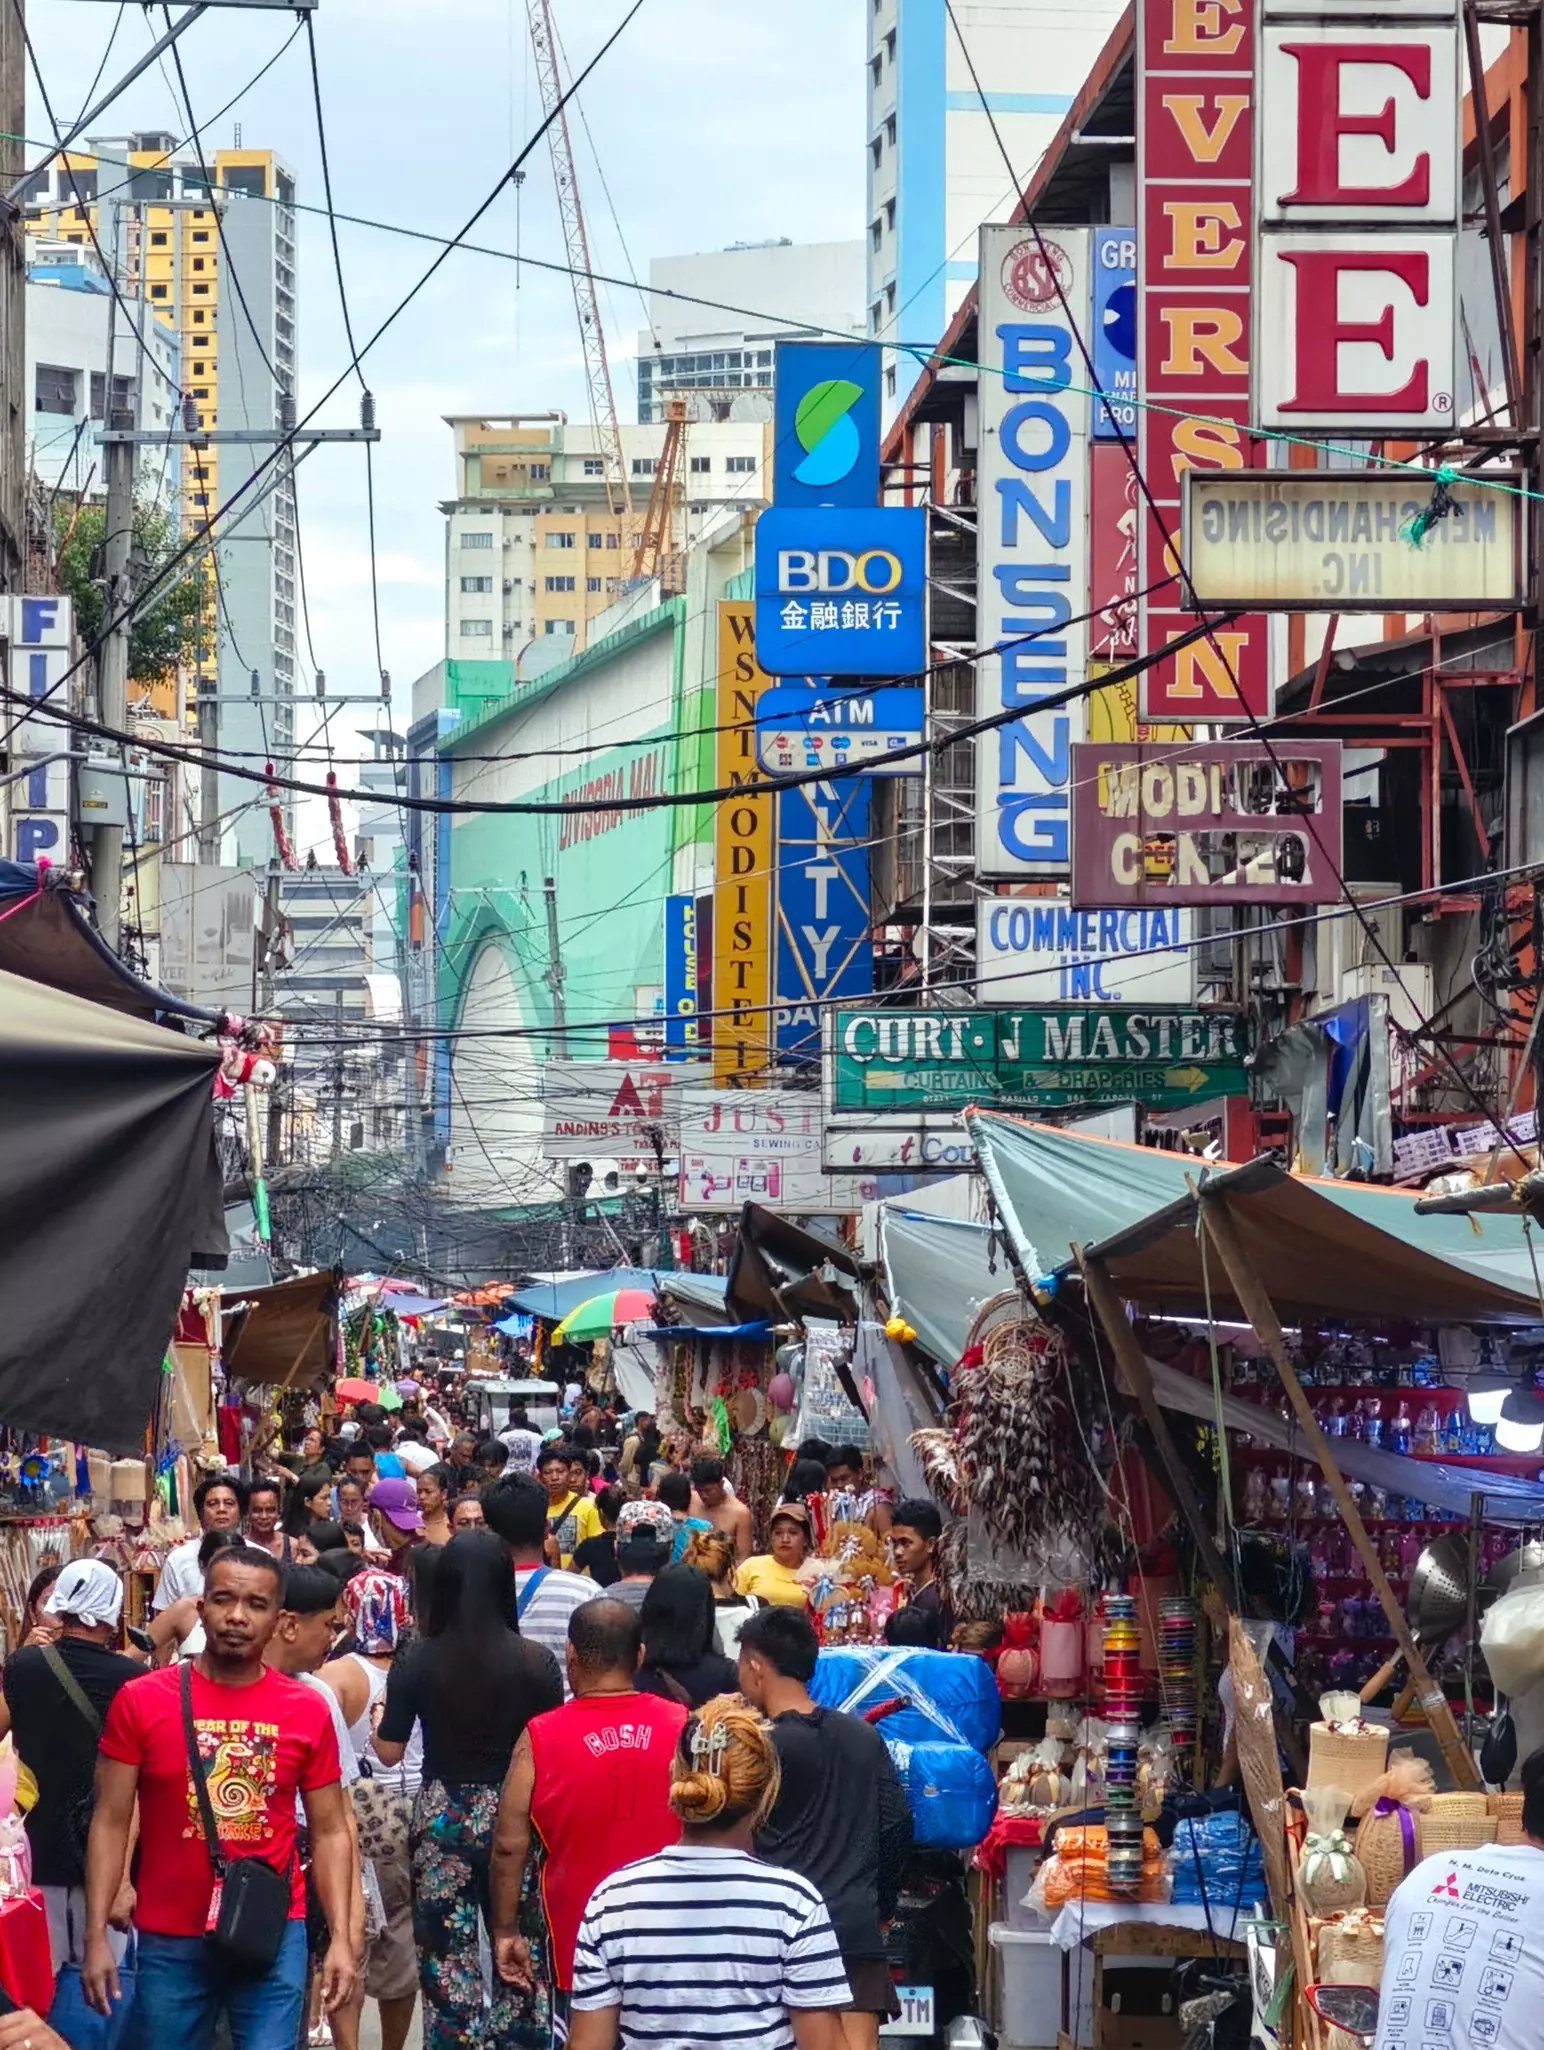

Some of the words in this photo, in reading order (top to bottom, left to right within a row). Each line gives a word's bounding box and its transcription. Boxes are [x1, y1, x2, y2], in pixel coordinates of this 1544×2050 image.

[778, 549, 903, 594] BDO
[994, 323, 1072, 862] BONSENG
[780, 600, 903, 630] 金融銀行
[808, 699, 874, 724] ATM
[990, 906, 1188, 953] COMMERCIAL
[1060, 955, 1121, 1000] INC.
[1042, 1014, 1240, 1061] MASTER
[903, 1071, 1000, 1089] CURTAINS
[253, 1722, 280, 1737] THE
[583, 1724, 652, 1758] BOSH
[1462, 1890, 1517, 1912] ELECTRIC
[1467, 1882, 1531, 1905] MITSUBISHI
